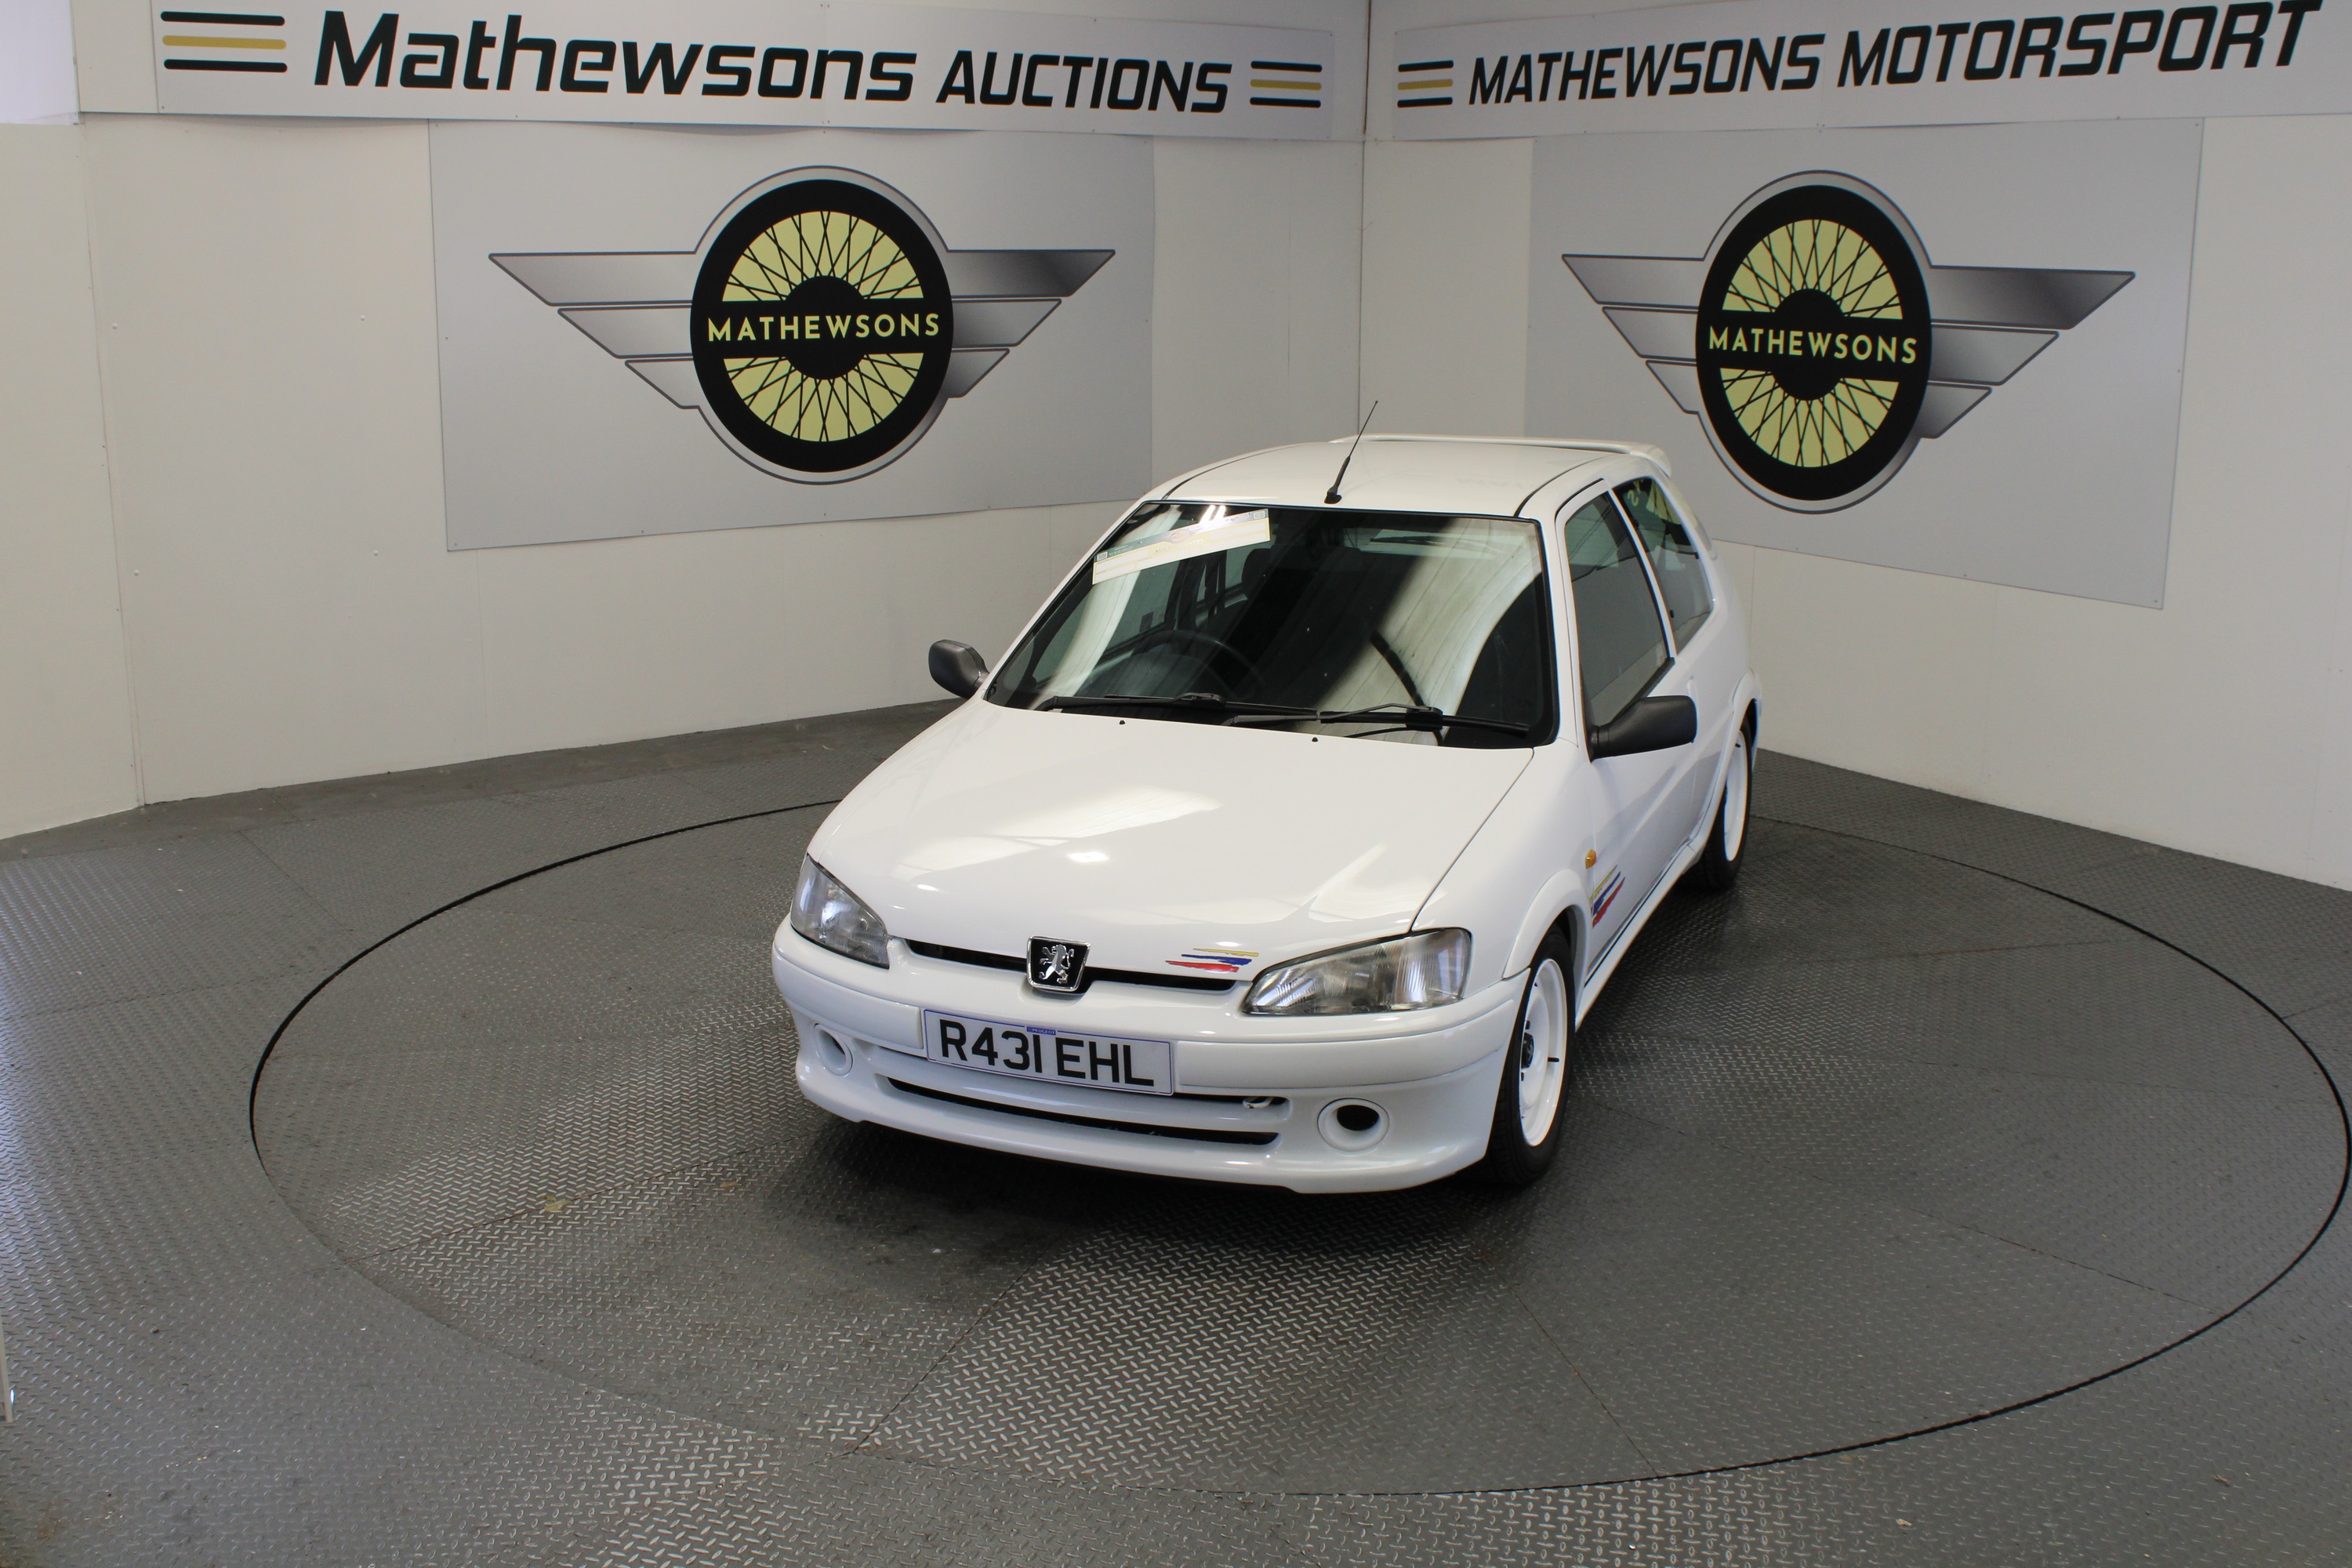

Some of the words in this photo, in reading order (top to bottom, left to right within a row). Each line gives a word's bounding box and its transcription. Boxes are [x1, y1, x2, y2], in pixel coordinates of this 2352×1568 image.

[314, 11, 917, 101] Mathewsons
[936, 50, 1232, 113] AUCTIONS
[1468, 34, 1826, 105] MATHEWSONS
[1837, 0, 2323, 87] MOTORSPORT
[708, 314, 939, 342] MATHEWSONS
[1709, 326, 1917, 364] MATHEWSONS
[939, 1018, 1043, 1073] R431
[1055, 1037, 1154, 1087] EHL
